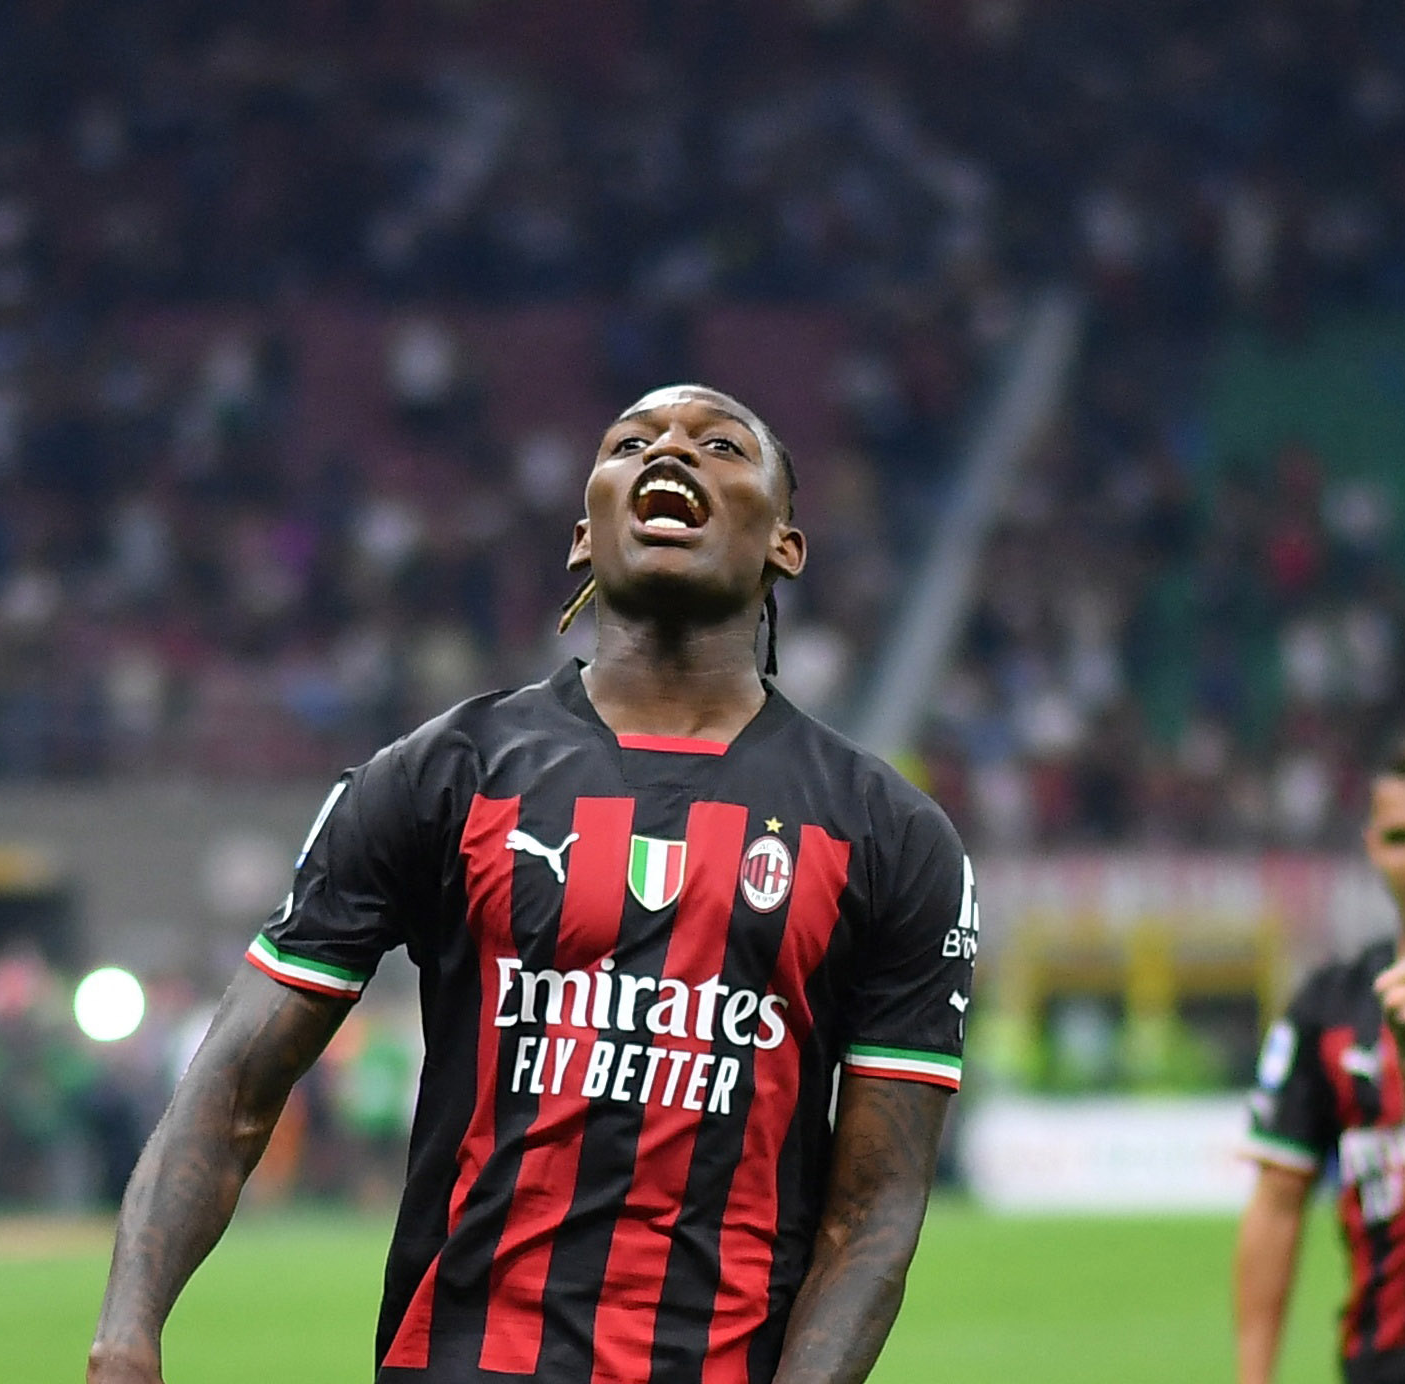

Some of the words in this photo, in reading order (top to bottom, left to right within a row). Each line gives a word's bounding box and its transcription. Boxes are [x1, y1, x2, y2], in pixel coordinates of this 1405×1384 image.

[494, 956, 789, 1050] Emirates
[511, 1036, 577, 1095] FLY
[581, 1040, 740, 1115] BETTER
